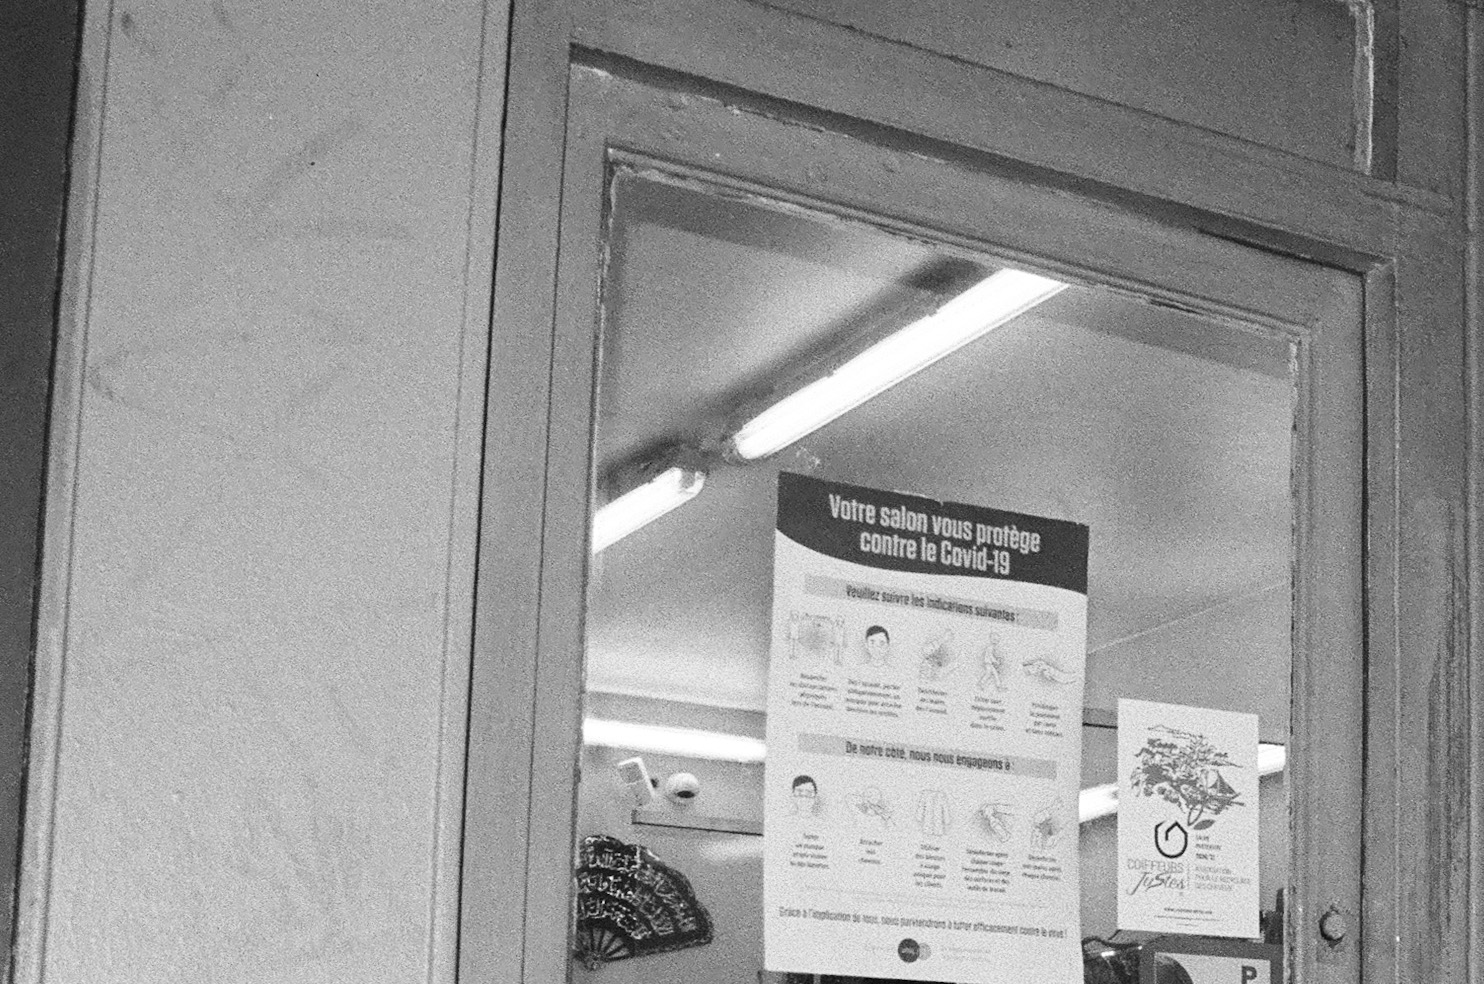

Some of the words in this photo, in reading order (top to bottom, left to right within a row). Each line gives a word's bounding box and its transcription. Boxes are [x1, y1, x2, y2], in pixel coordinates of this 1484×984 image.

[829, 493, 876, 525] Votre
[879, 505, 928, 534] salon
[932, 515, 972, 541] vous
[976, 522, 1041, 554] protège
[859, 531, 917, 560] contre
[921, 536, 937, 562] le
[940, 540, 1011, 576] Covid-19
